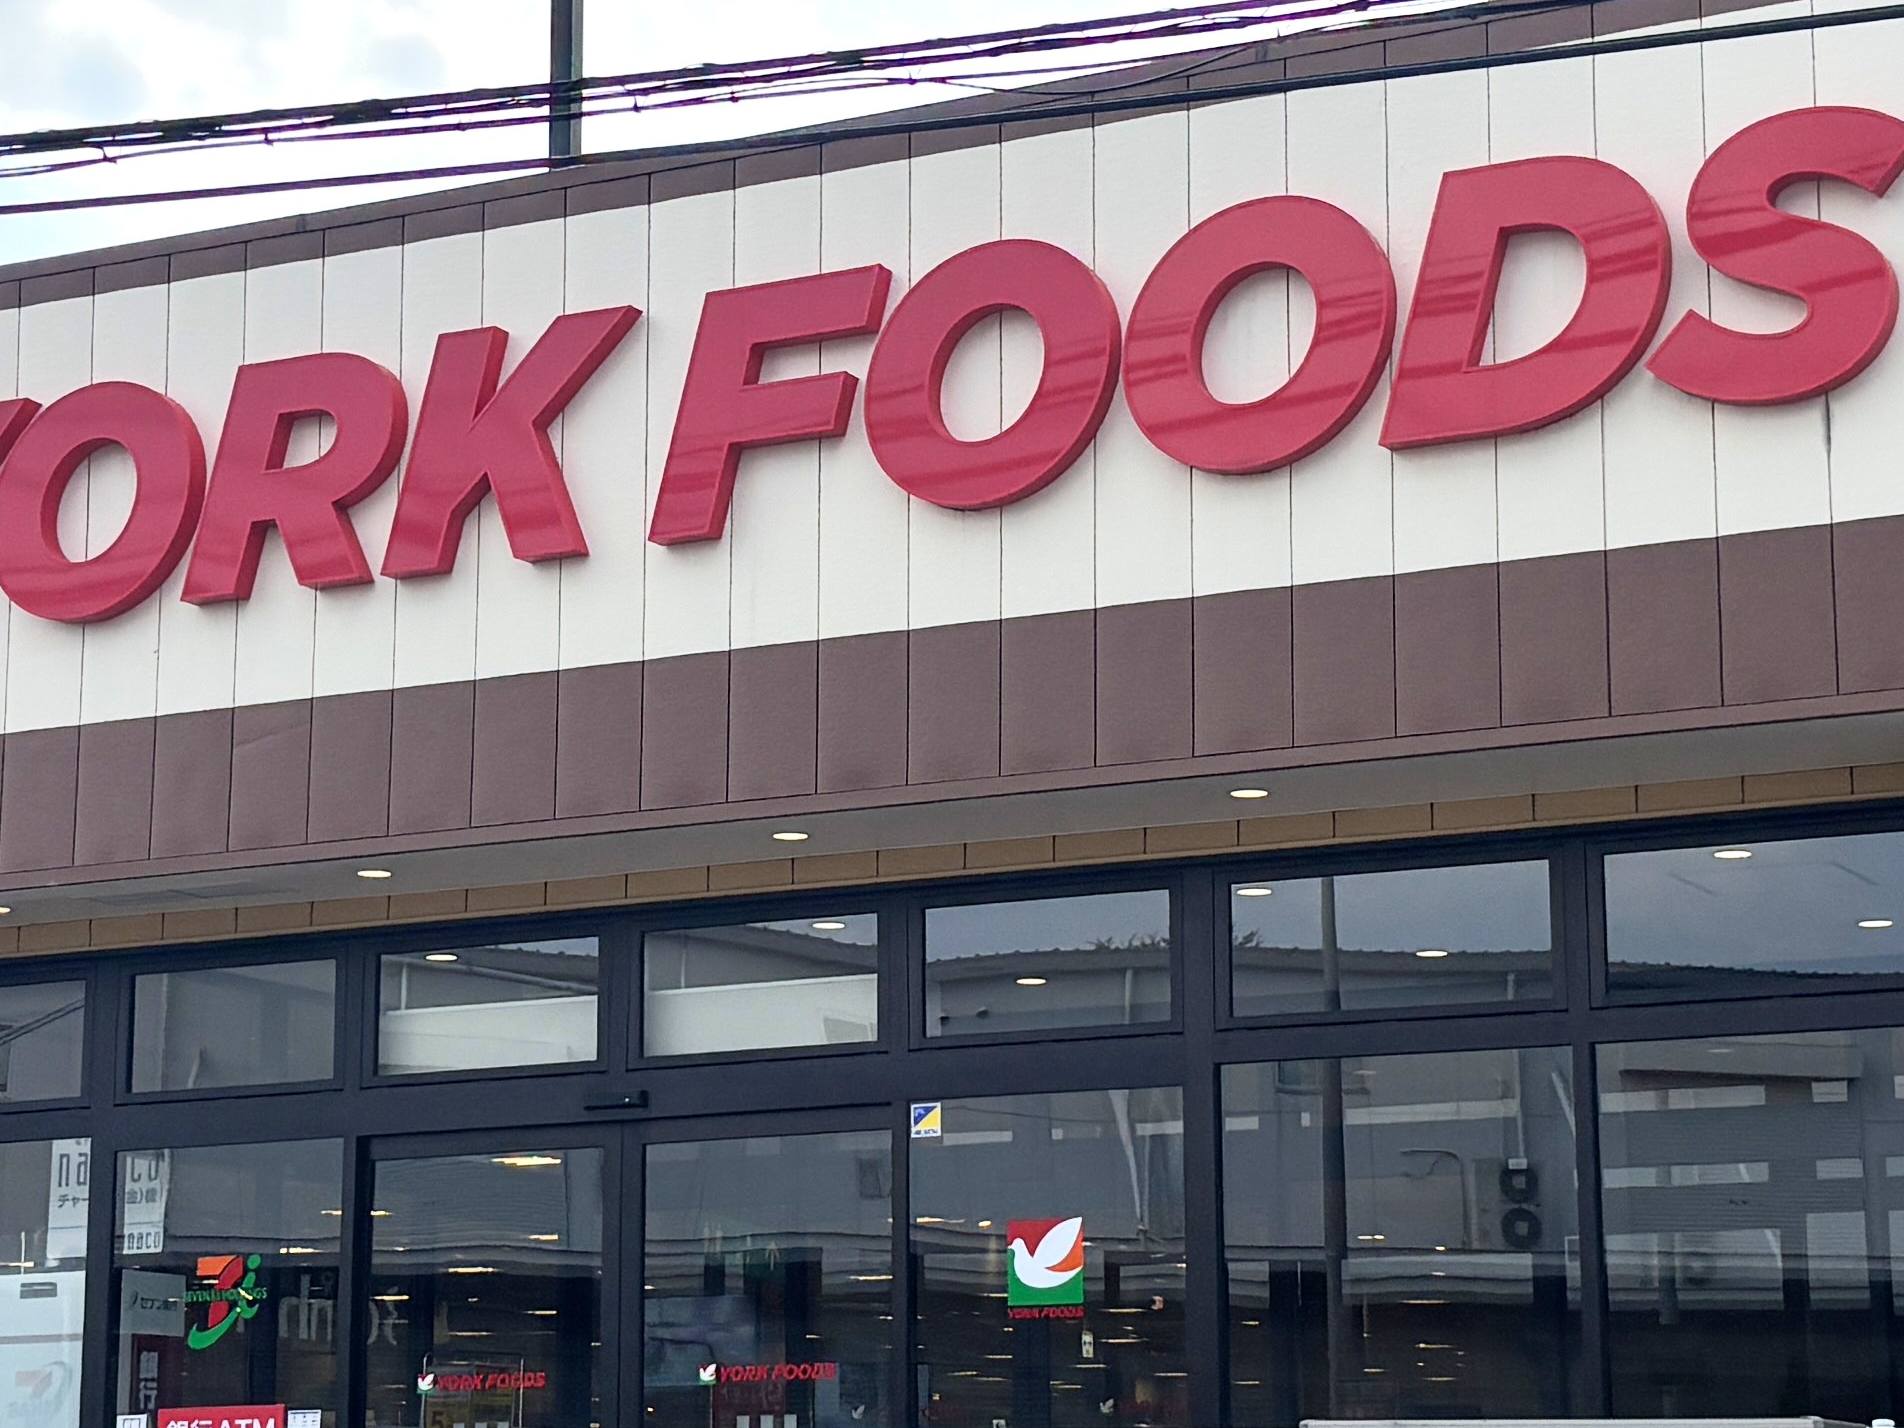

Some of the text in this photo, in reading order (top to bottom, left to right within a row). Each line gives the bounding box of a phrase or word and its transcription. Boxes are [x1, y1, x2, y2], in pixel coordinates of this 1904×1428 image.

[437, 1371, 546, 1392] YORK FOODS
[720, 1363, 838, 1383] YORK FOODS
